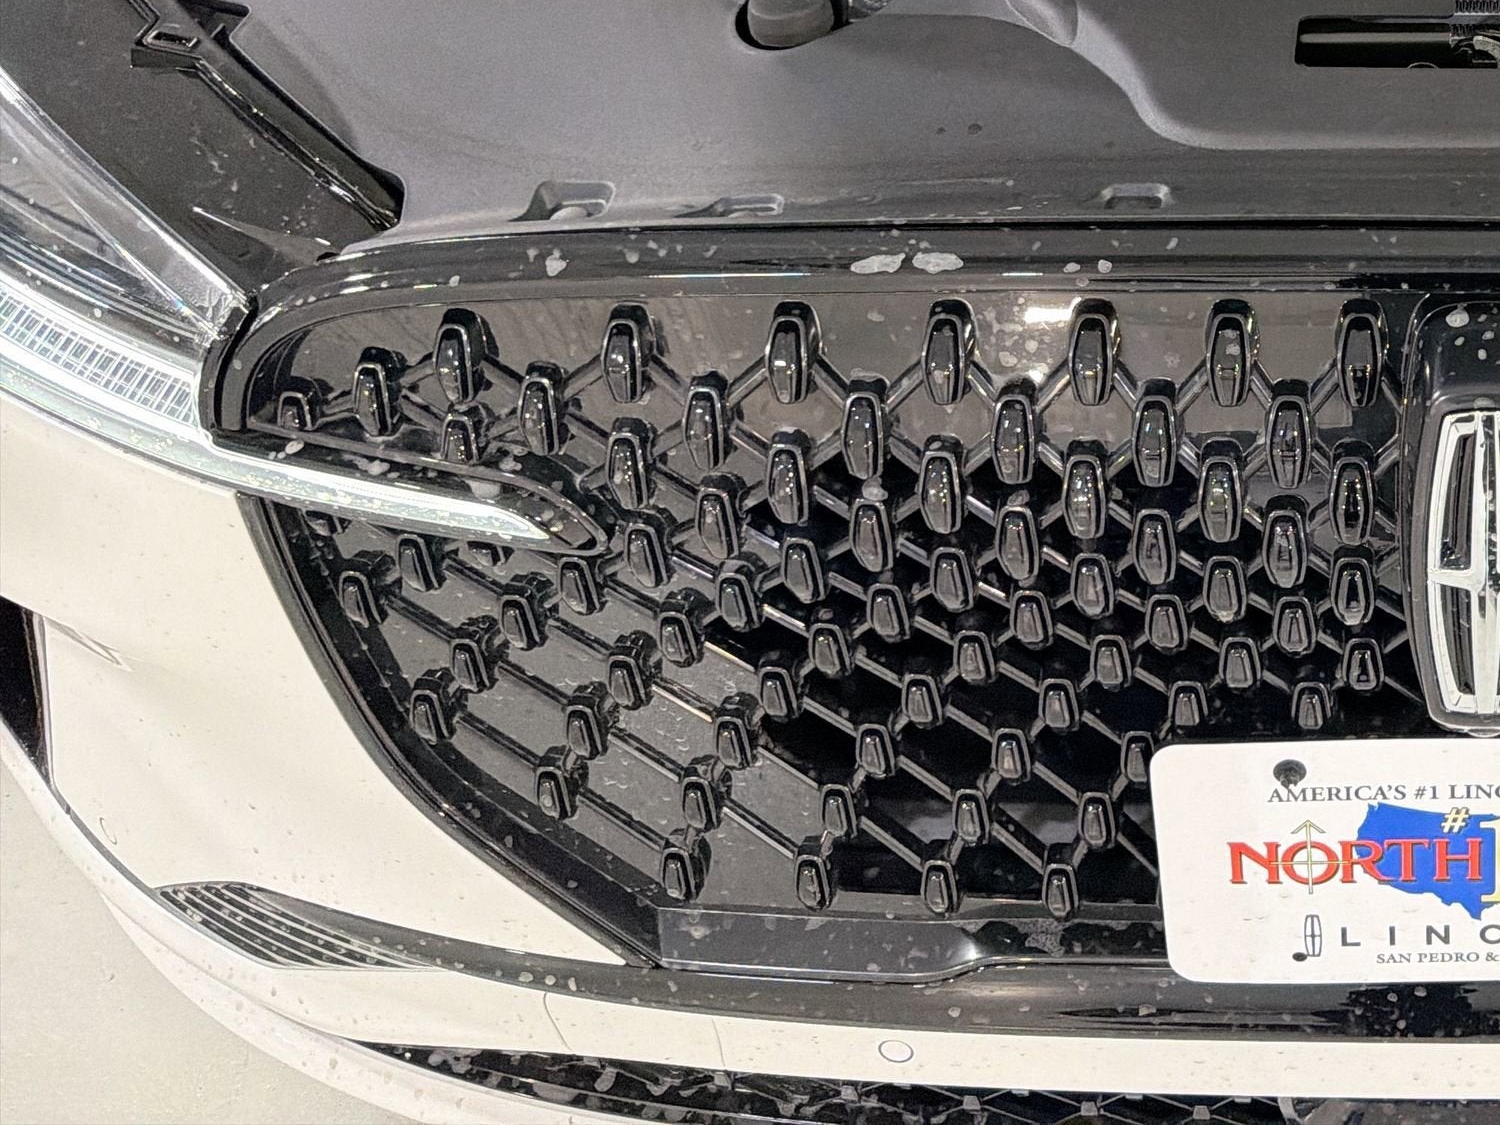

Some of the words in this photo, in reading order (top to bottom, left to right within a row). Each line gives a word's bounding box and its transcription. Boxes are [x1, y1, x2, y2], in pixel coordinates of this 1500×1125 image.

[1267, 784, 1407, 803] AMERICA'S
[1414, 785, 1440, 800] #1
[1226, 837, 1482, 885] NORTH
[1376, 953, 1416, 964] SAN
[1418, 952, 1480, 963] PEDRO
[1485, 951, 1500, 962] &
